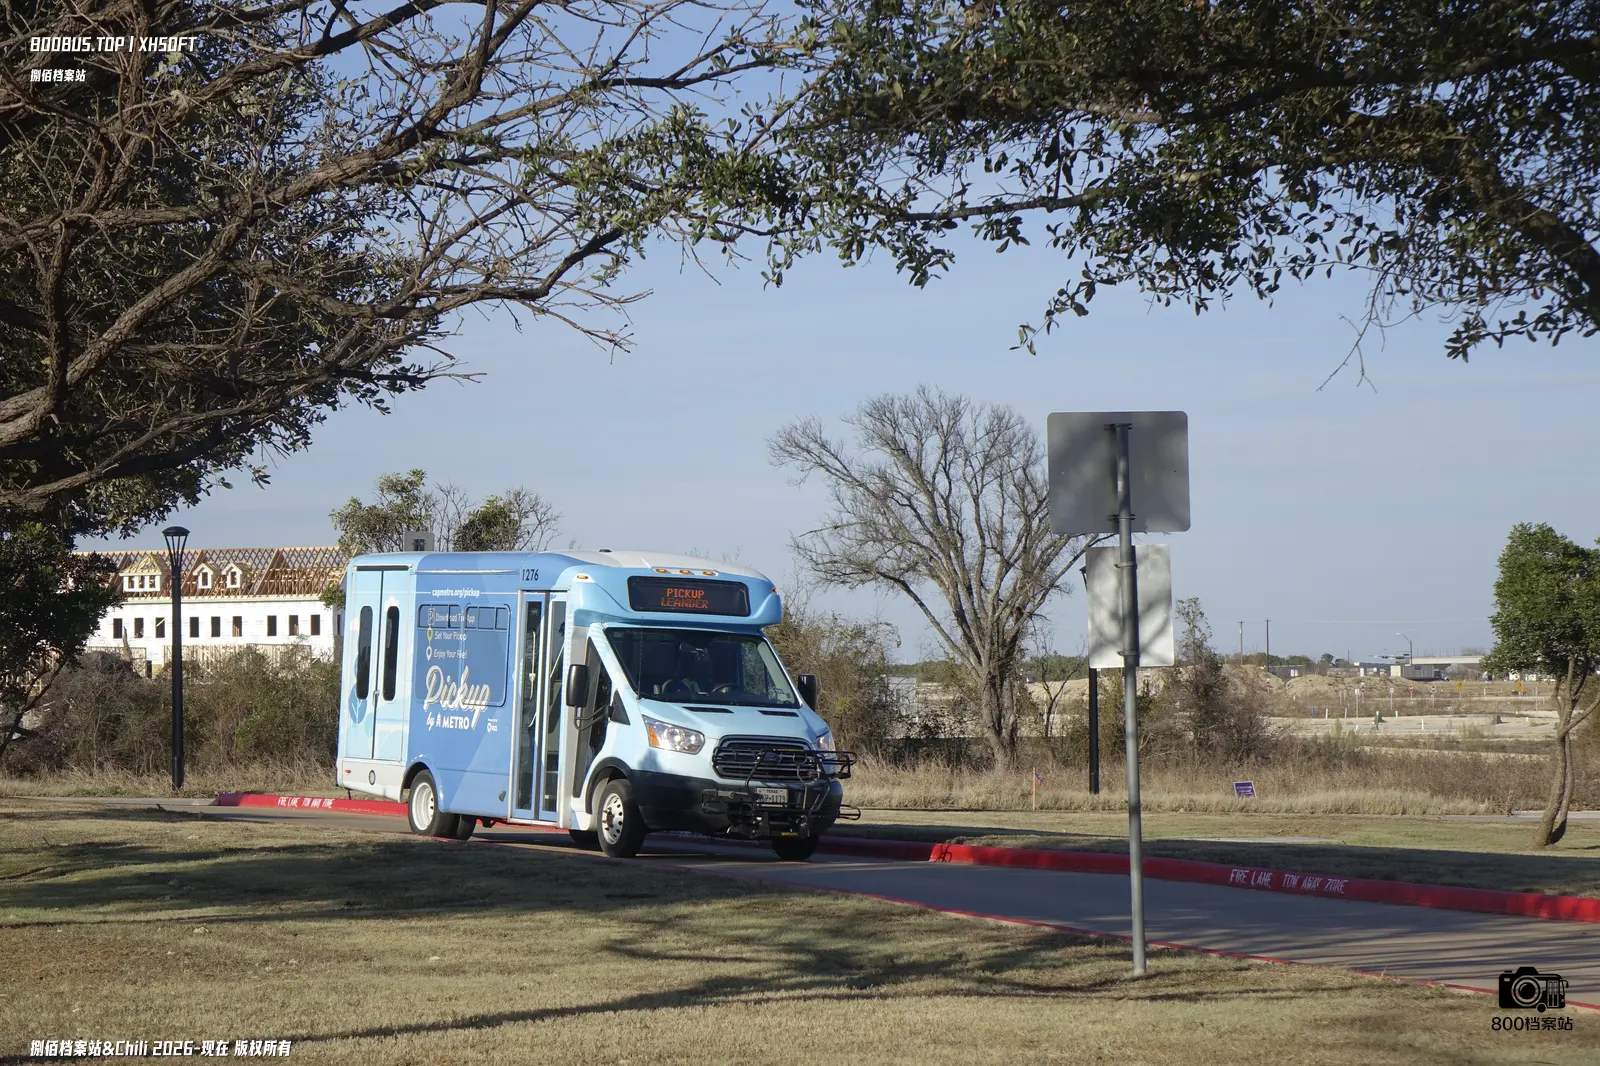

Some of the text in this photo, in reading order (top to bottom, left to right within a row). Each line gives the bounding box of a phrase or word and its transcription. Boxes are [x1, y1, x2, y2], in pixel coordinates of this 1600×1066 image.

[522, 569, 539, 581] 1276
[432, 588, 480, 598] capmetro.org/pickup
[666, 587, 705, 599] PICKUP
[660, 597, 709, 609] LEANDER
[434, 631, 442, 640] Set
[442, 631, 452, 640] Your
[433, 649, 468, 660] Enjoy Your Rie!
[423, 665, 491, 730] Pickup
[426, 712, 469, 731] by METRO
[1229, 868, 1349, 894] FIRE LANE TOW AWAY ZONE
